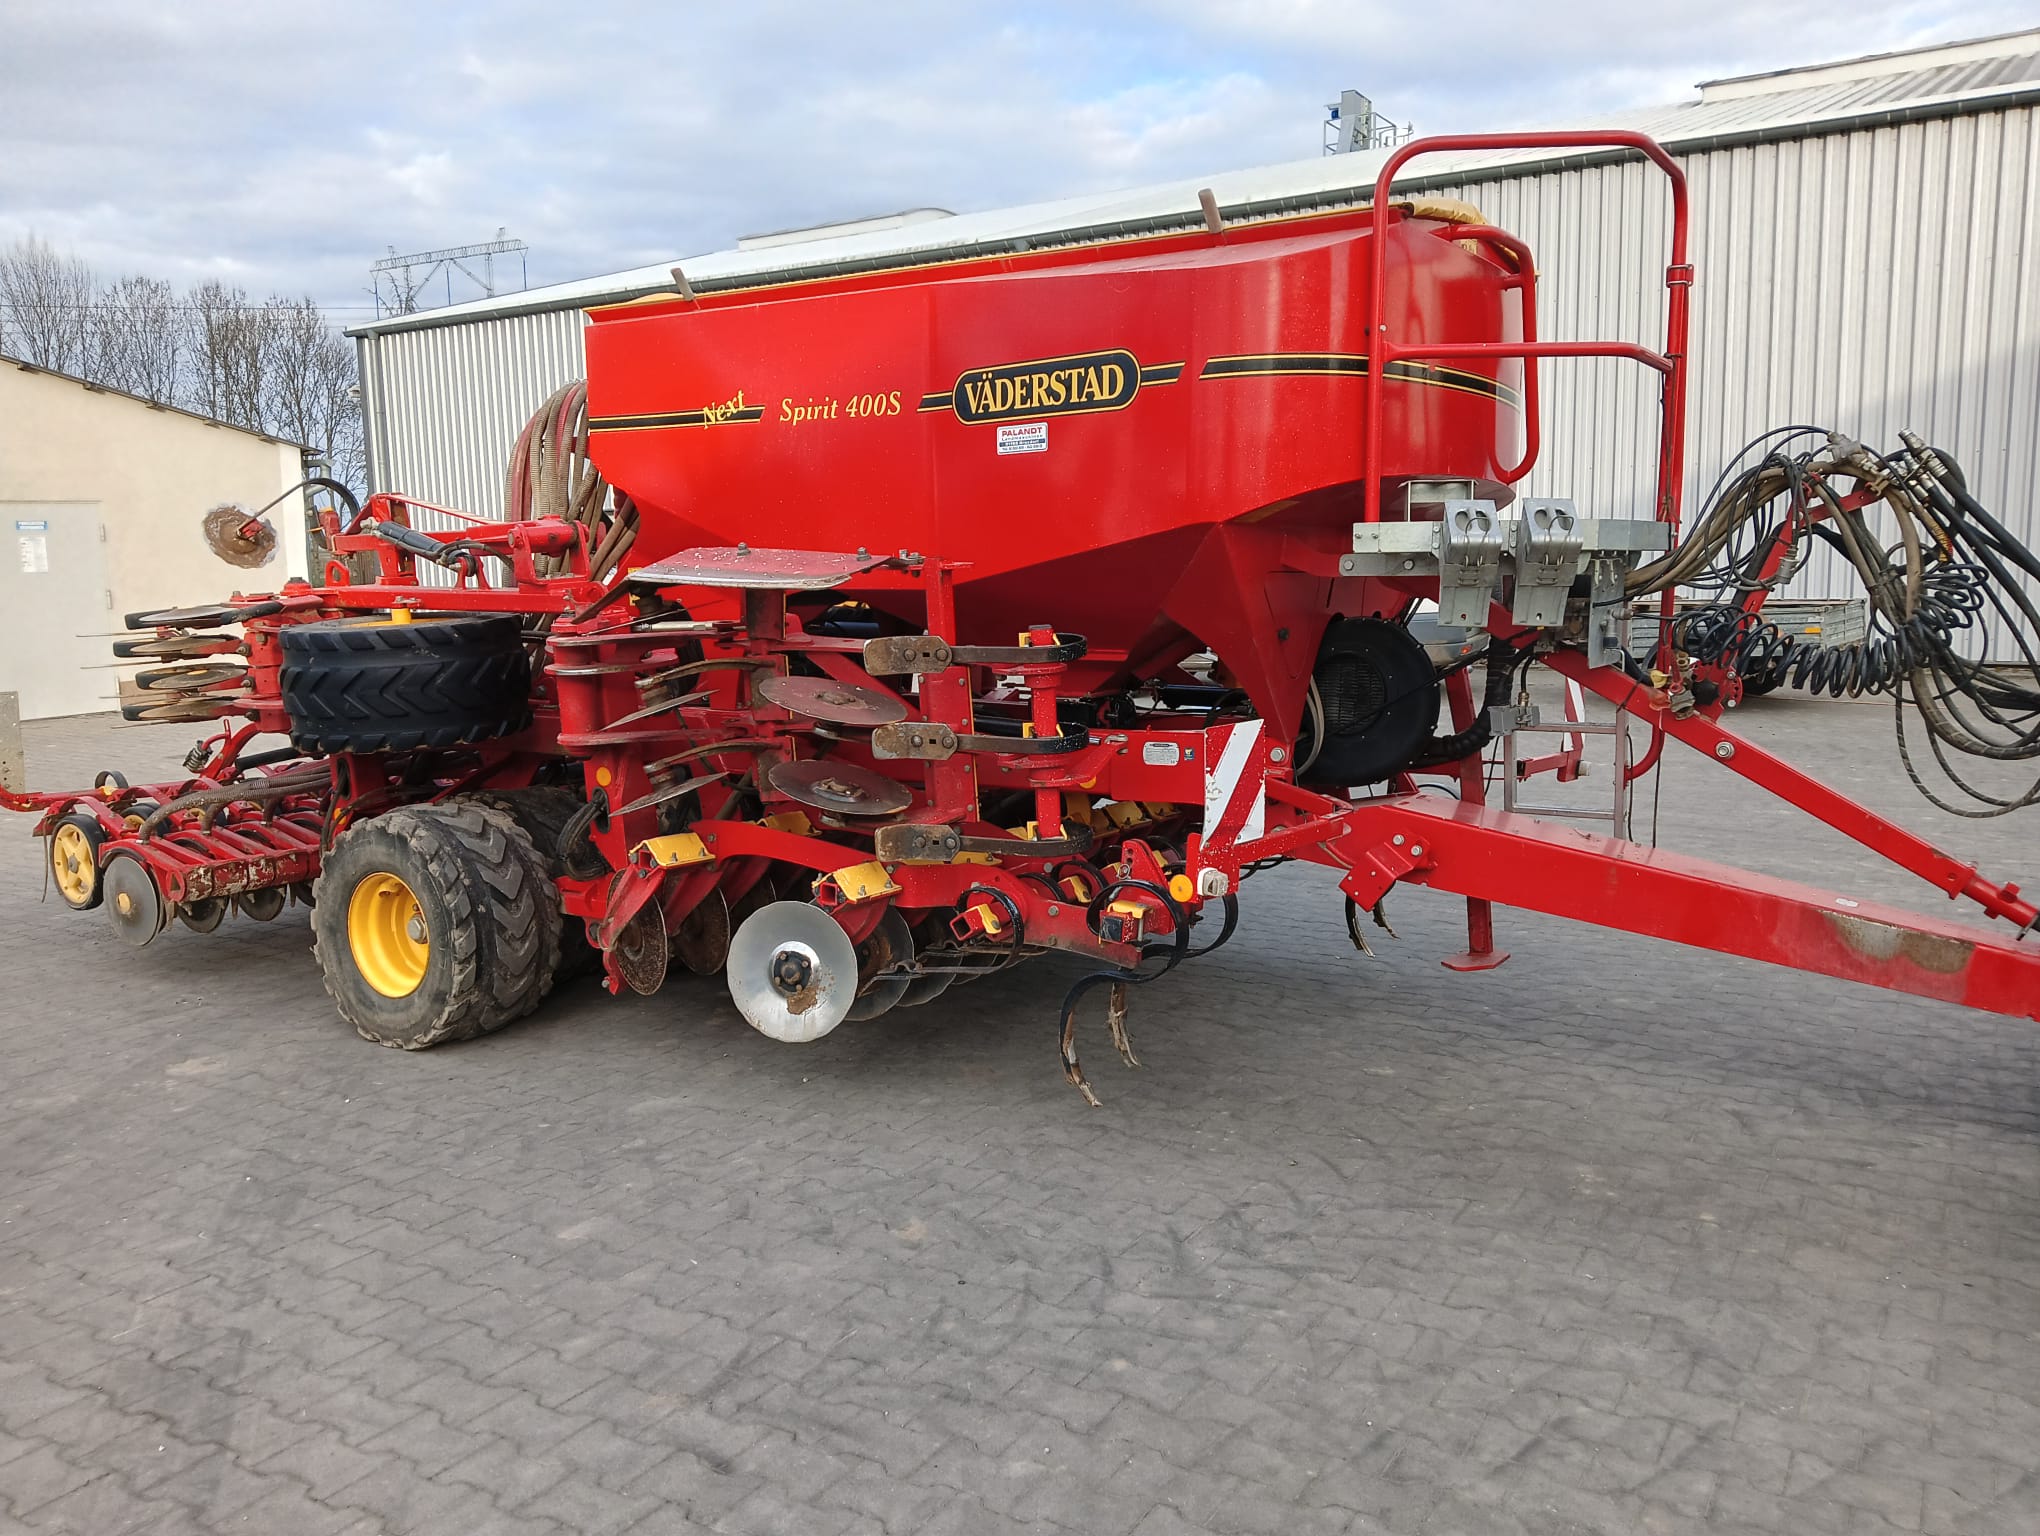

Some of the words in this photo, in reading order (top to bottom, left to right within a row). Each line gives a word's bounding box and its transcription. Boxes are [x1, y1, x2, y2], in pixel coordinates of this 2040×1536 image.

[964, 364, 1125, 415] VÄDERSTAD
[703, 390, 745, 430] Next
[780, 396, 839, 426] Spirit
[845, 391, 901, 418] 400S
[1001, 426, 1043, 437] PALANDT
